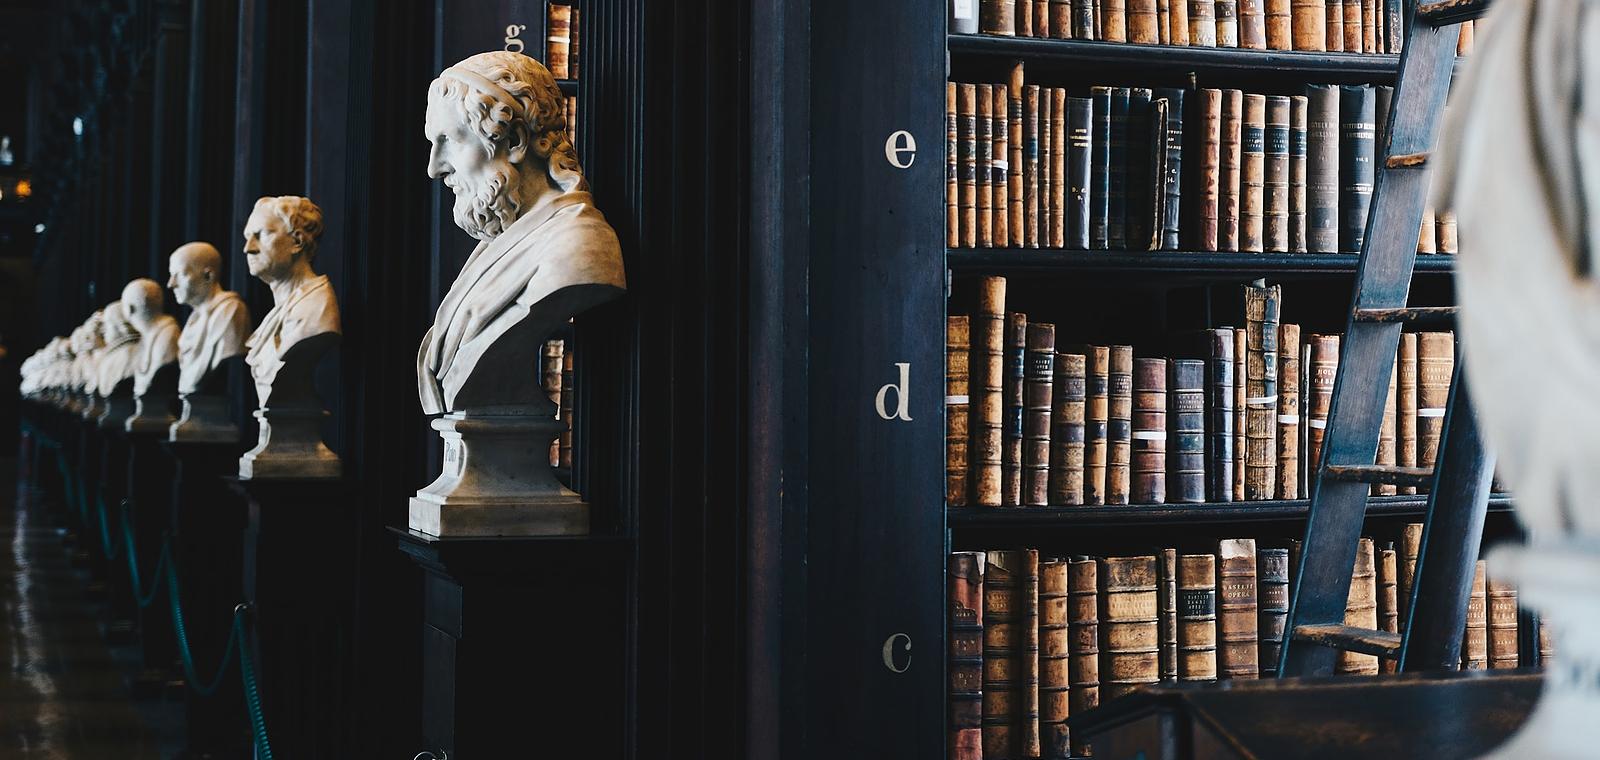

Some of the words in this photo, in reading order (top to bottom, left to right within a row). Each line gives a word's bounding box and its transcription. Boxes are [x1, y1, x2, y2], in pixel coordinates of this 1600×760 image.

[505, 24, 526, 53] g
[885, 130, 916, 168] e
[875, 363, 913, 421] d
[883, 633, 911, 673] c
